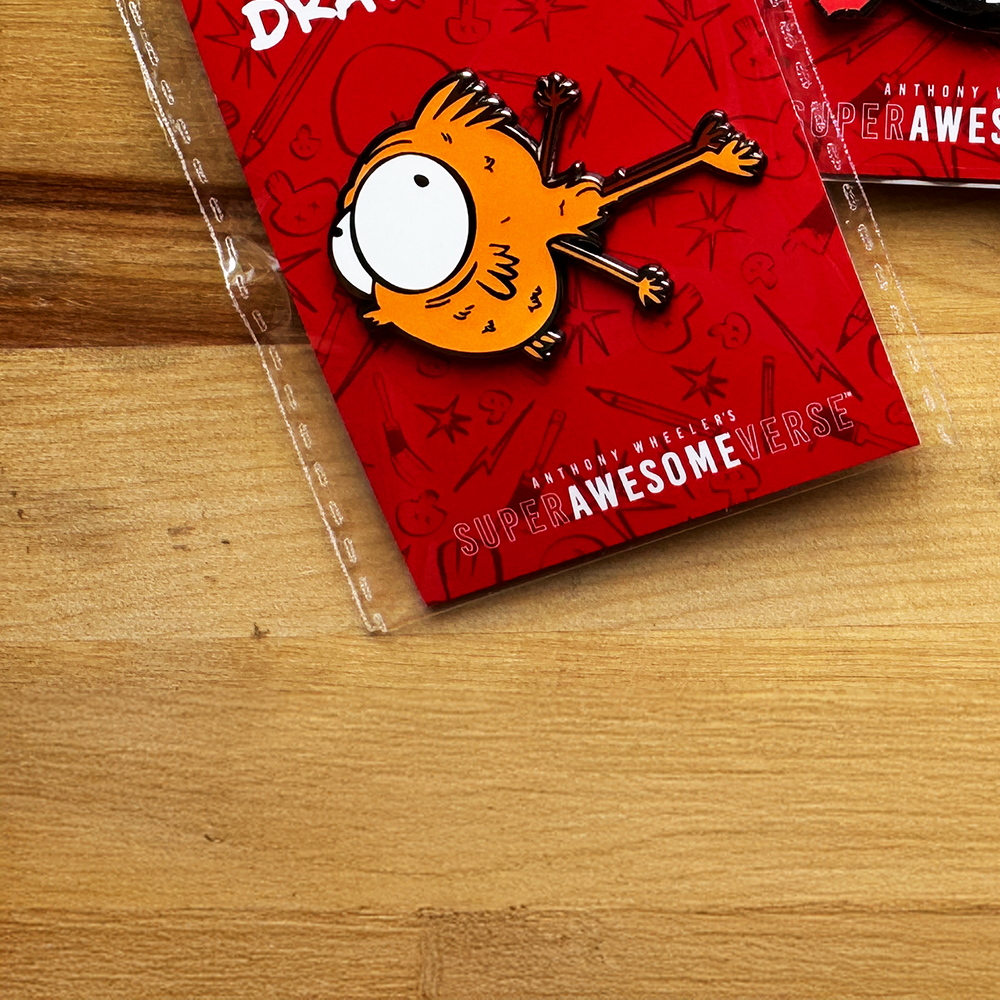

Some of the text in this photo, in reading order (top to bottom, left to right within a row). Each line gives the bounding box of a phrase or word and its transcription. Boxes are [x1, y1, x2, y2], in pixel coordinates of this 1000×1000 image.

[884, 82, 979, 99] ANTHONY
[531, 409, 737, 488] ANTHONY WHEELER'S
